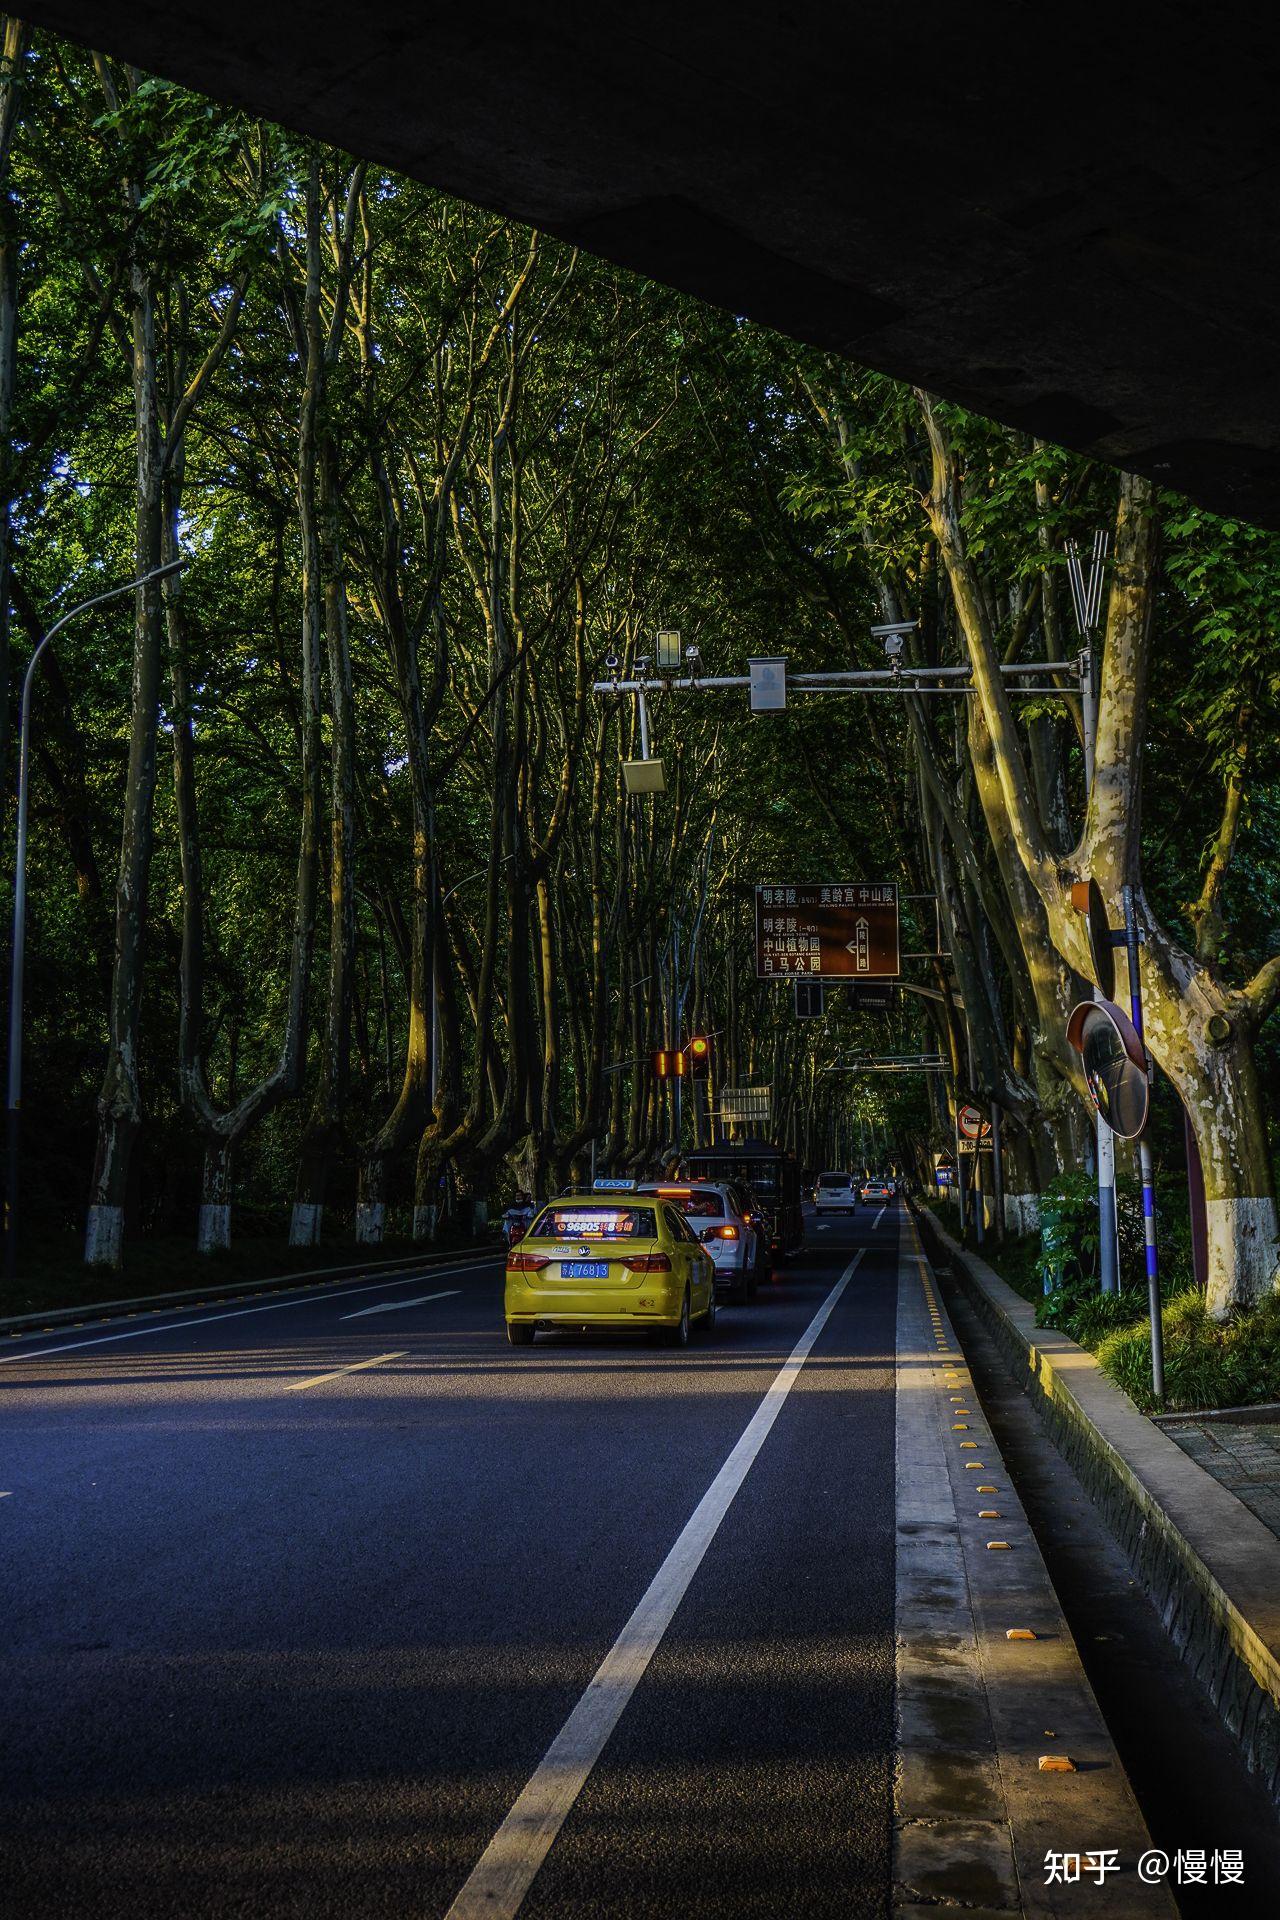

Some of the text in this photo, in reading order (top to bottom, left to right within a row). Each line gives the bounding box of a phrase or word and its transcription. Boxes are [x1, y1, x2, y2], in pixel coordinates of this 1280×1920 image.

[763, 890, 796, 904] 明孝陵
[821, 888, 854, 902] 美龄宫
[860, 887, 893, 902] 中山陵
[763, 918, 797, 933] 明孝陵
[763, 937, 820, 952] 中山植物园
[764, 957, 820, 972] 白马公园
